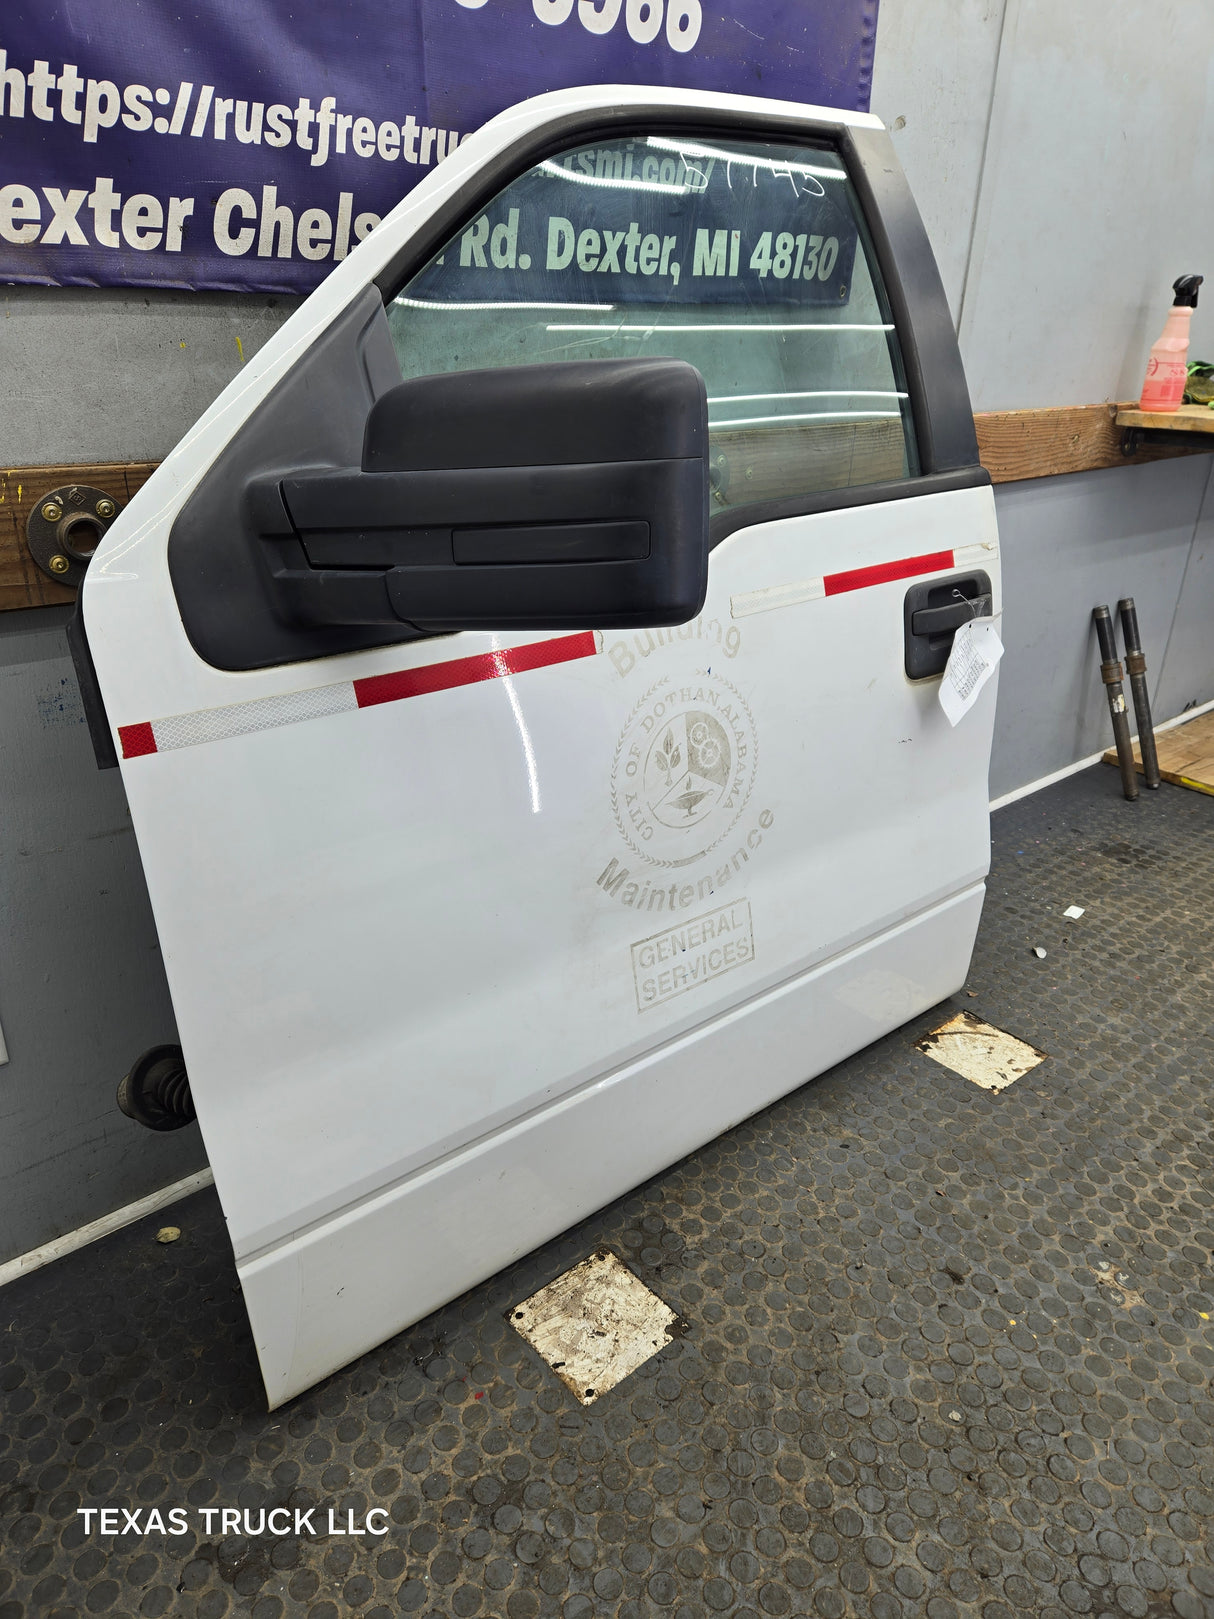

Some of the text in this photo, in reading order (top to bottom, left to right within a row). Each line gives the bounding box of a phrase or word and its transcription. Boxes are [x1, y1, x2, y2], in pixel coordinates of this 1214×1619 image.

[459, 208, 532, 270] Rd.
[546, 216, 681, 286] Dexter,
[692, 228, 741, 277] MI
[749, 231, 839, 282] 48130
[625, 742, 641, 778] OF
[720, 703, 747, 809] ALABAMA
[625, 792, 653, 841] CITY
[597, 808, 774, 912] Maintenance
[638, 909, 743, 970] GENERAL
[642, 936, 750, 1002] SERVICES
